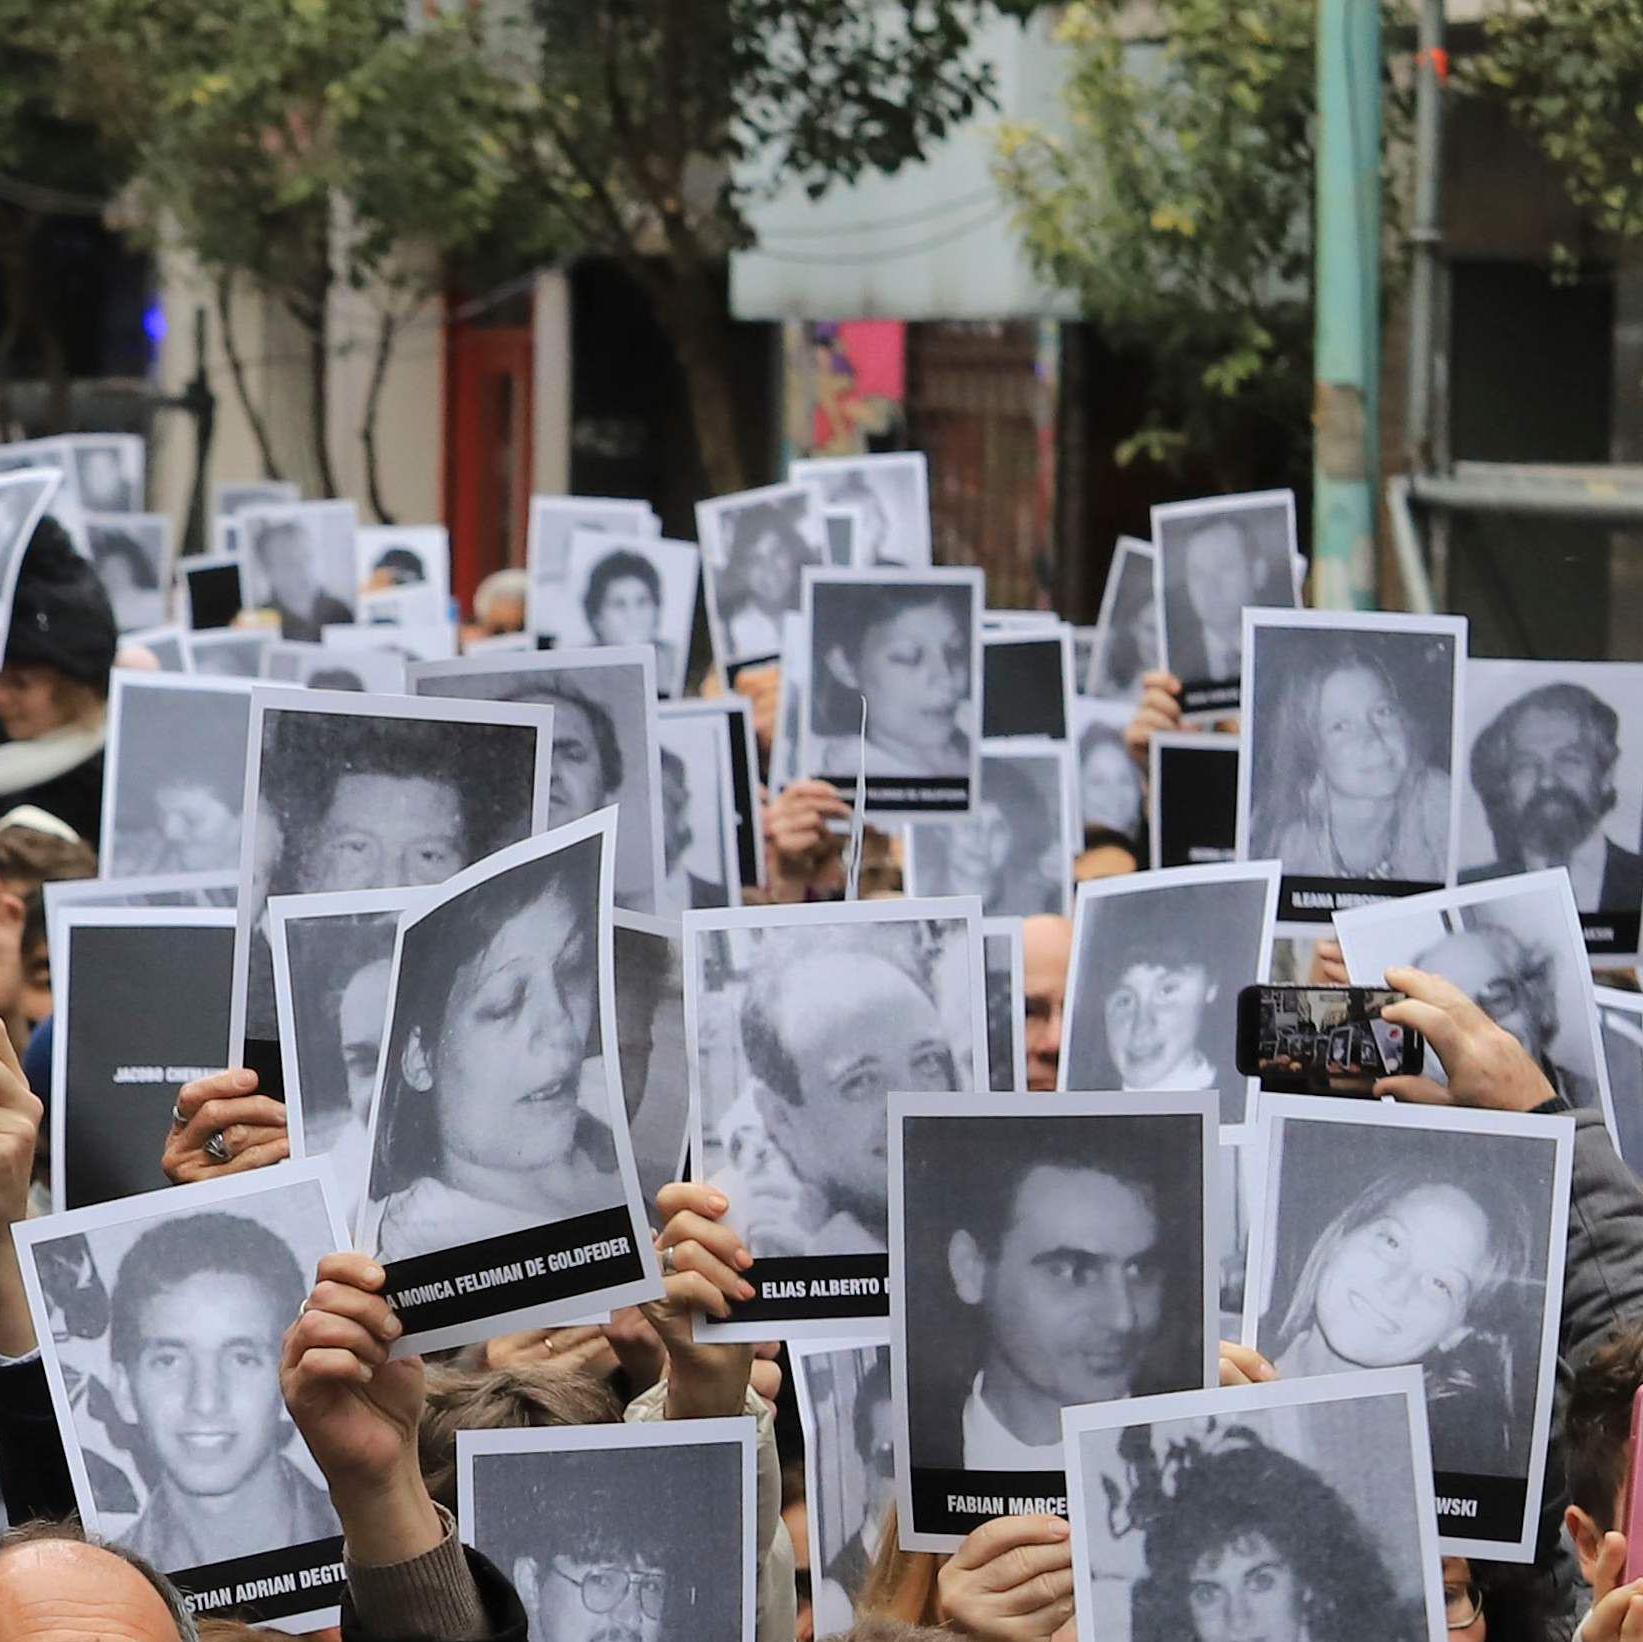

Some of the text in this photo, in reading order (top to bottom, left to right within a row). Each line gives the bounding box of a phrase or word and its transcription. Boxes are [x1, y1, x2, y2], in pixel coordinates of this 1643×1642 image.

[397, 1279, 456, 1308] MONICA
[455, 1262, 524, 1295] FELDMAN
[525, 1256, 547, 1278] DE
[547, 1236, 631, 1276] GOLDFEDER
[761, 1280, 807, 1299] ELIAS
[809, 1277, 880, 1297] ALBERTO
[947, 1494, 1004, 1515] FABIAN
[235, 1572, 296, 1603] ADRIAN
